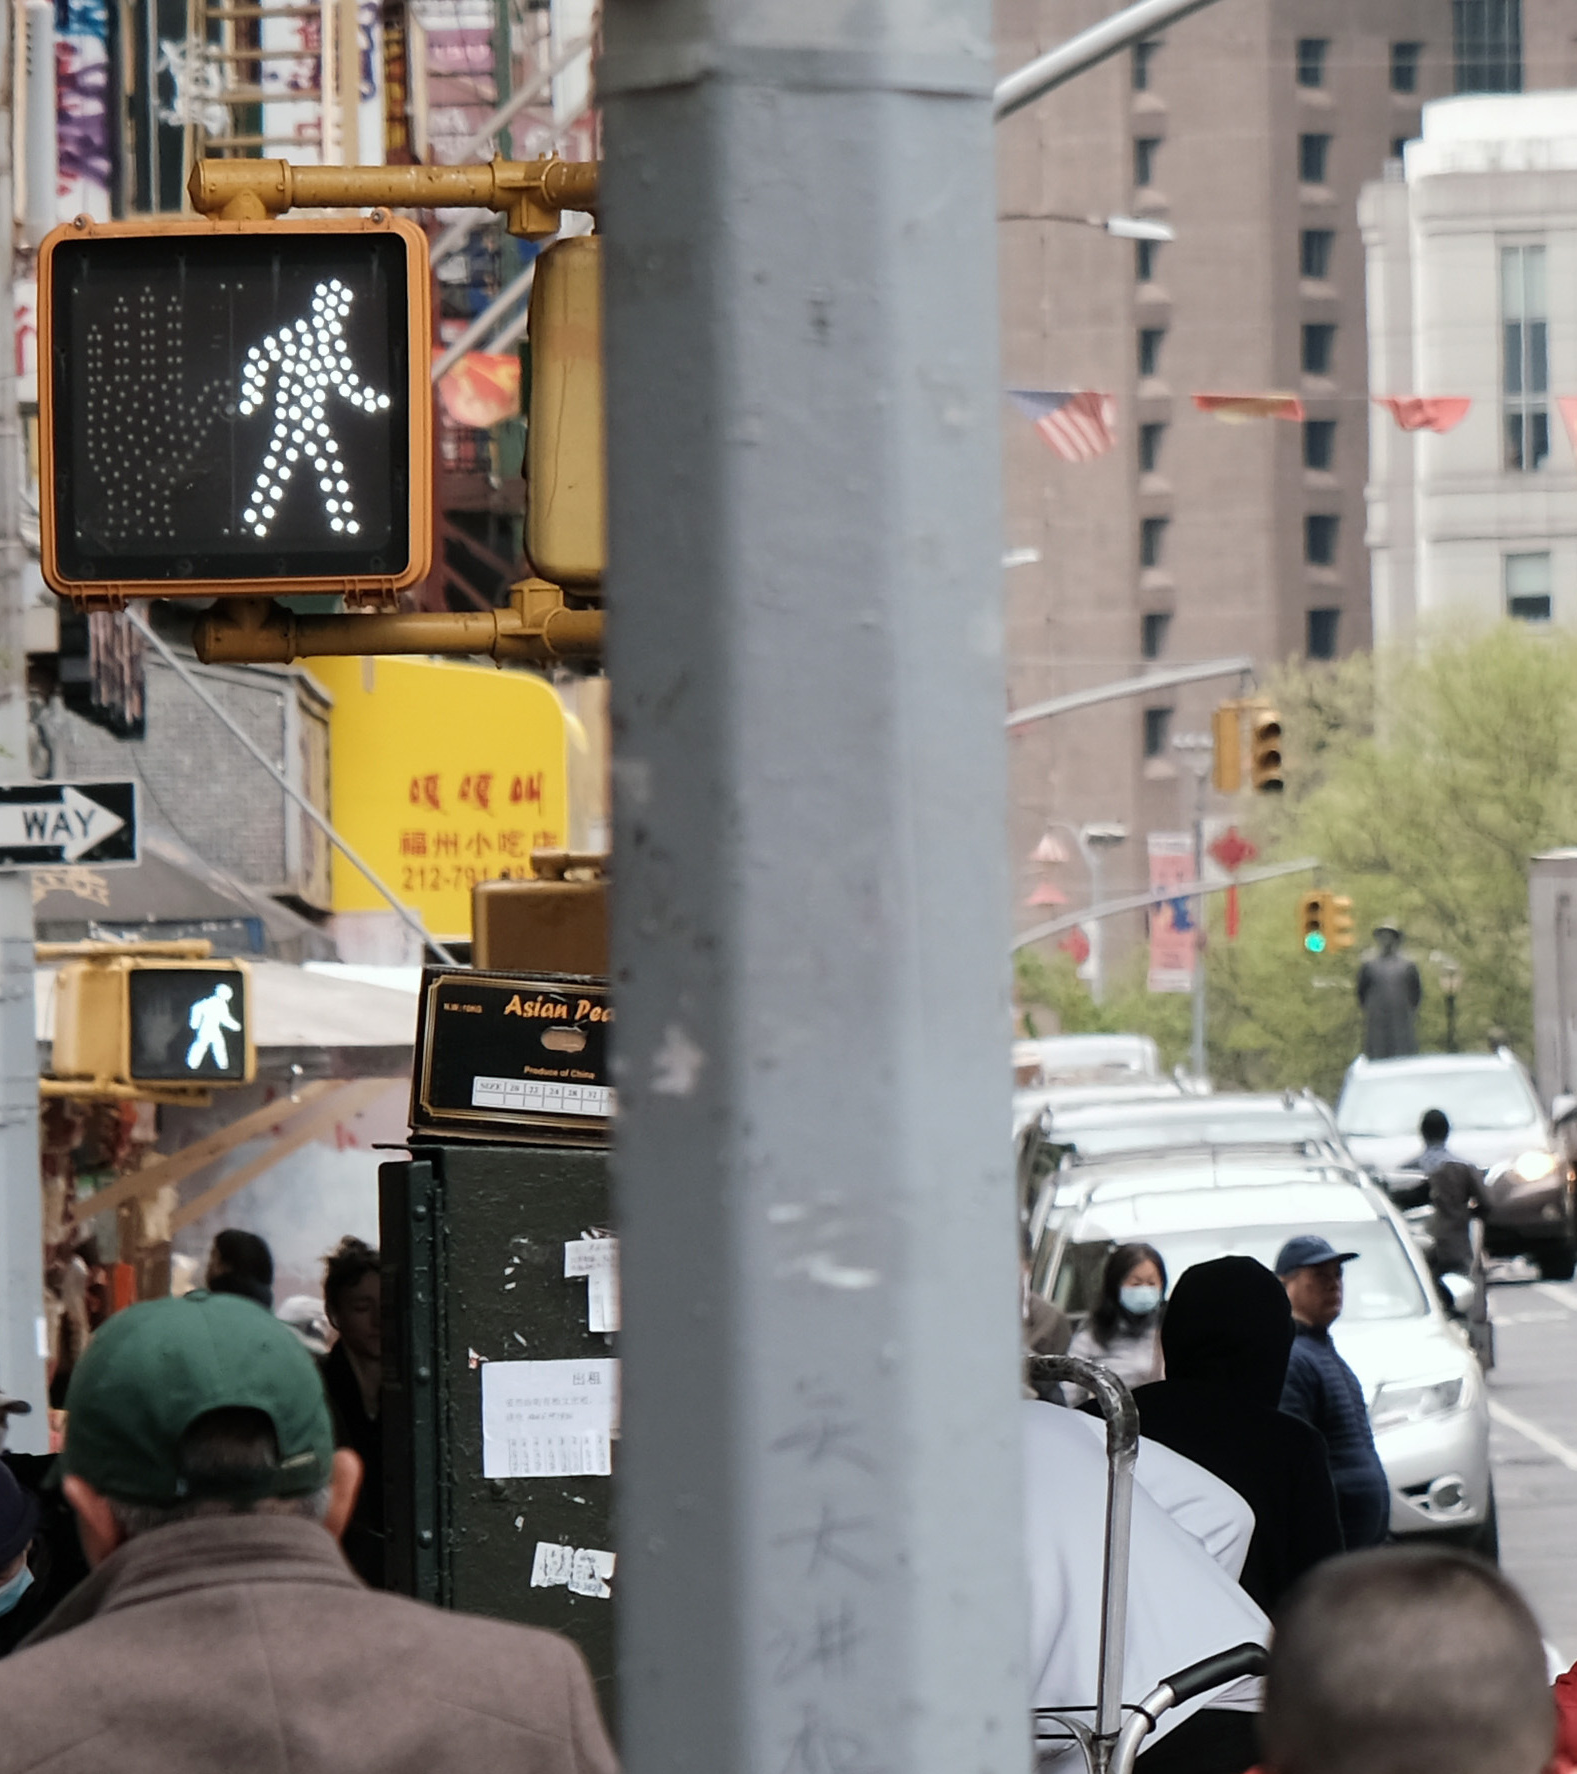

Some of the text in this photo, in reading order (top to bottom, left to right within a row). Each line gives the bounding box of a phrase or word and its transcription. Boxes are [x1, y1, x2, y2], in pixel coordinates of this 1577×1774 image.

[22, 808, 97, 841] WAY
[503, 993, 568, 1019] Asian
[523, 1065, 596, 1080] Produce of China
